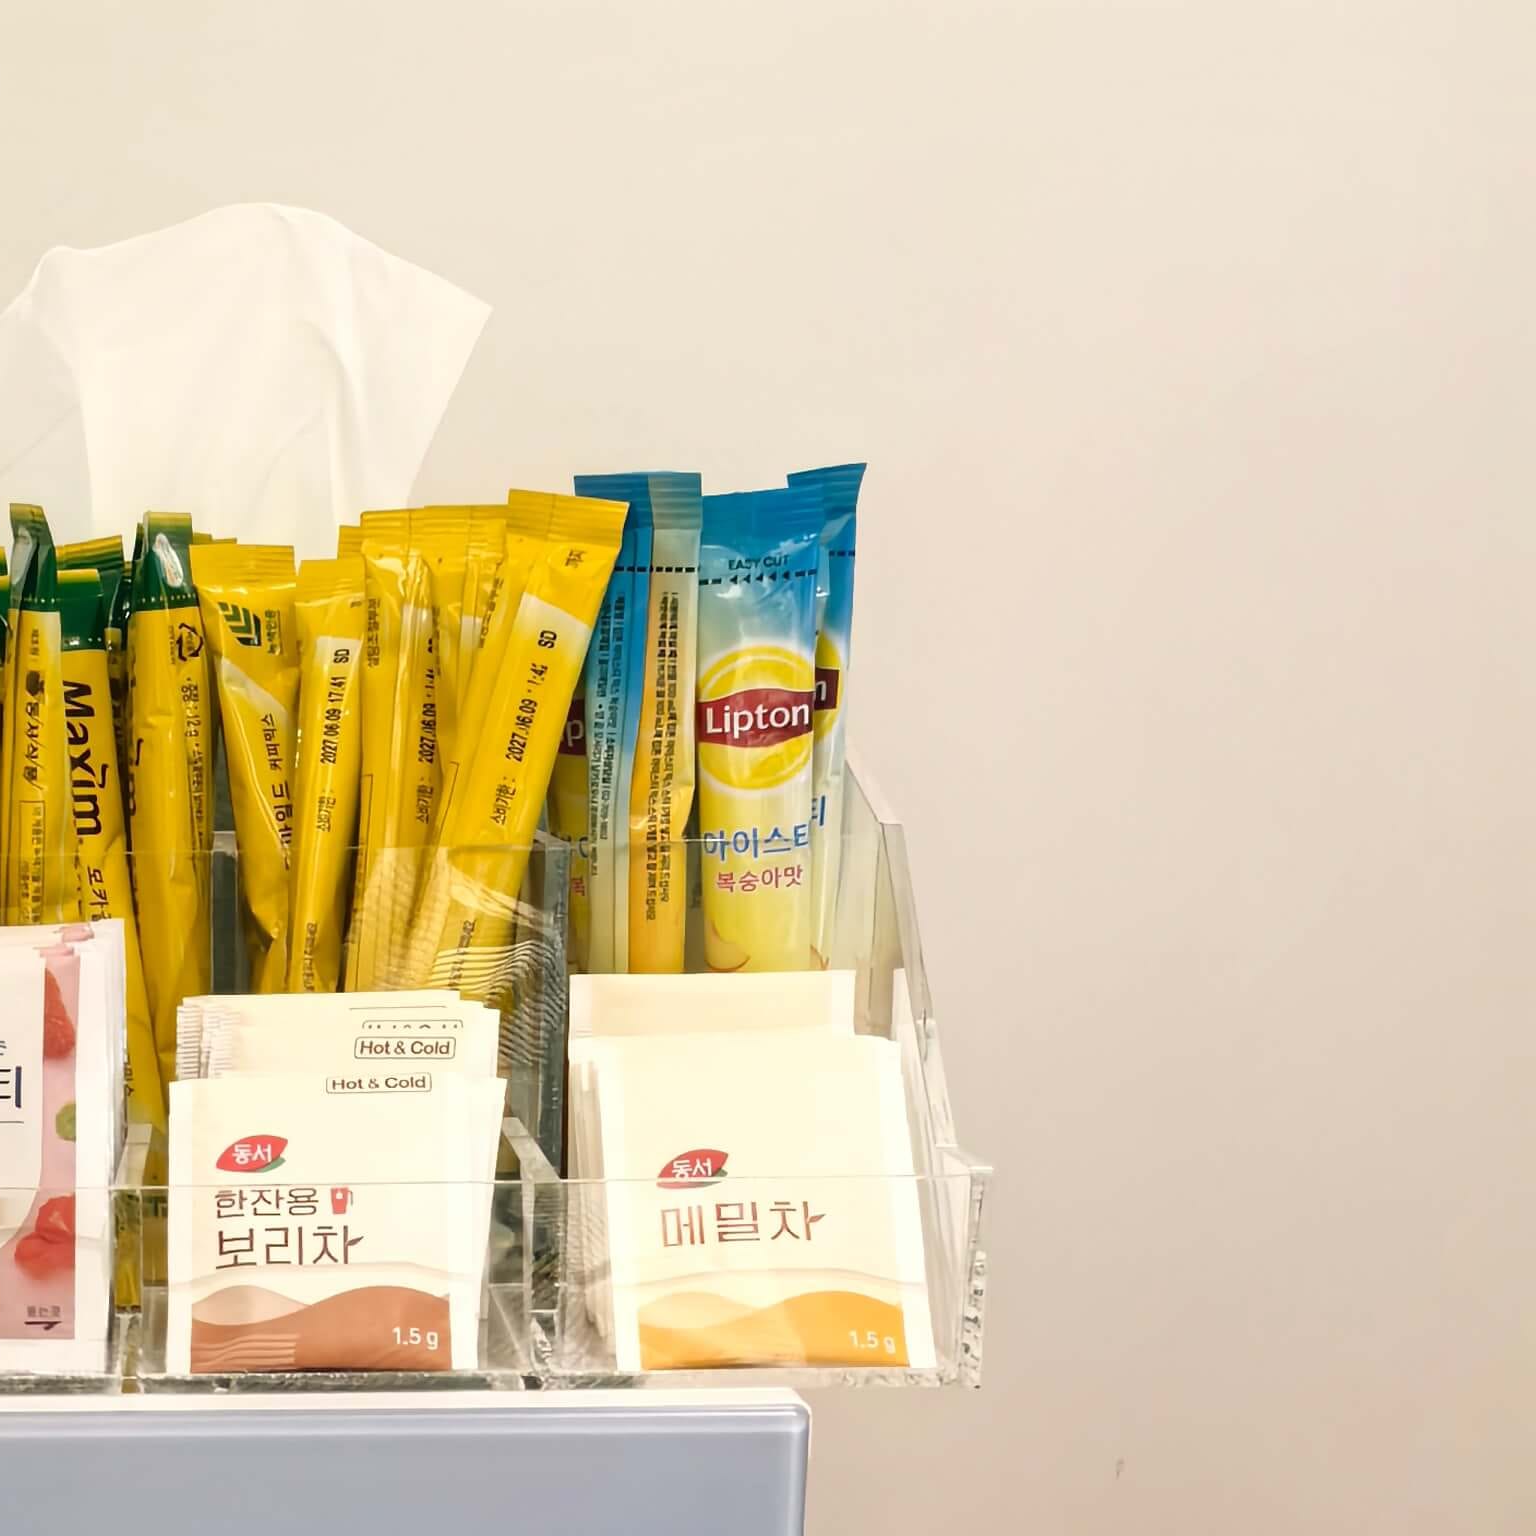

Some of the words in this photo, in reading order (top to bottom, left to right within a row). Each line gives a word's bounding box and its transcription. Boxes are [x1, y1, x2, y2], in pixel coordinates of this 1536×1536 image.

[728, 557, 758, 570] EASY
[763, 554, 788, 568] CUT
[537, 629, 557, 649] SD
[333, 648, 350, 664] SD
[706, 703, 810, 739] Lipton
[62, 680, 109, 837] Maxim
[716, 865, 803, 893] 복숭아맛
[359, 1040, 391, 1056] Hot
[394, 1040, 407, 1056] &
[410, 1040, 451, 1056] Cold
[331, 1077, 364, 1091] Hot
[367, 1077, 380, 1090] &
[384, 1075, 427, 1090] Cold
[231, 1143, 273, 1165] 동서
[671, 1158, 713, 1180] 동서
[214, 1187, 319, 1219] 한잔용
[661, 1200, 826, 1248] 메밀차
[215, 1224, 363, 1270] 보리차
[392, 1326, 421, 1346] 1.5
[425, 1331, 439, 1350] g
[849, 1329, 878, 1349] 1.5
[883, 1336, 896, 1354] g
